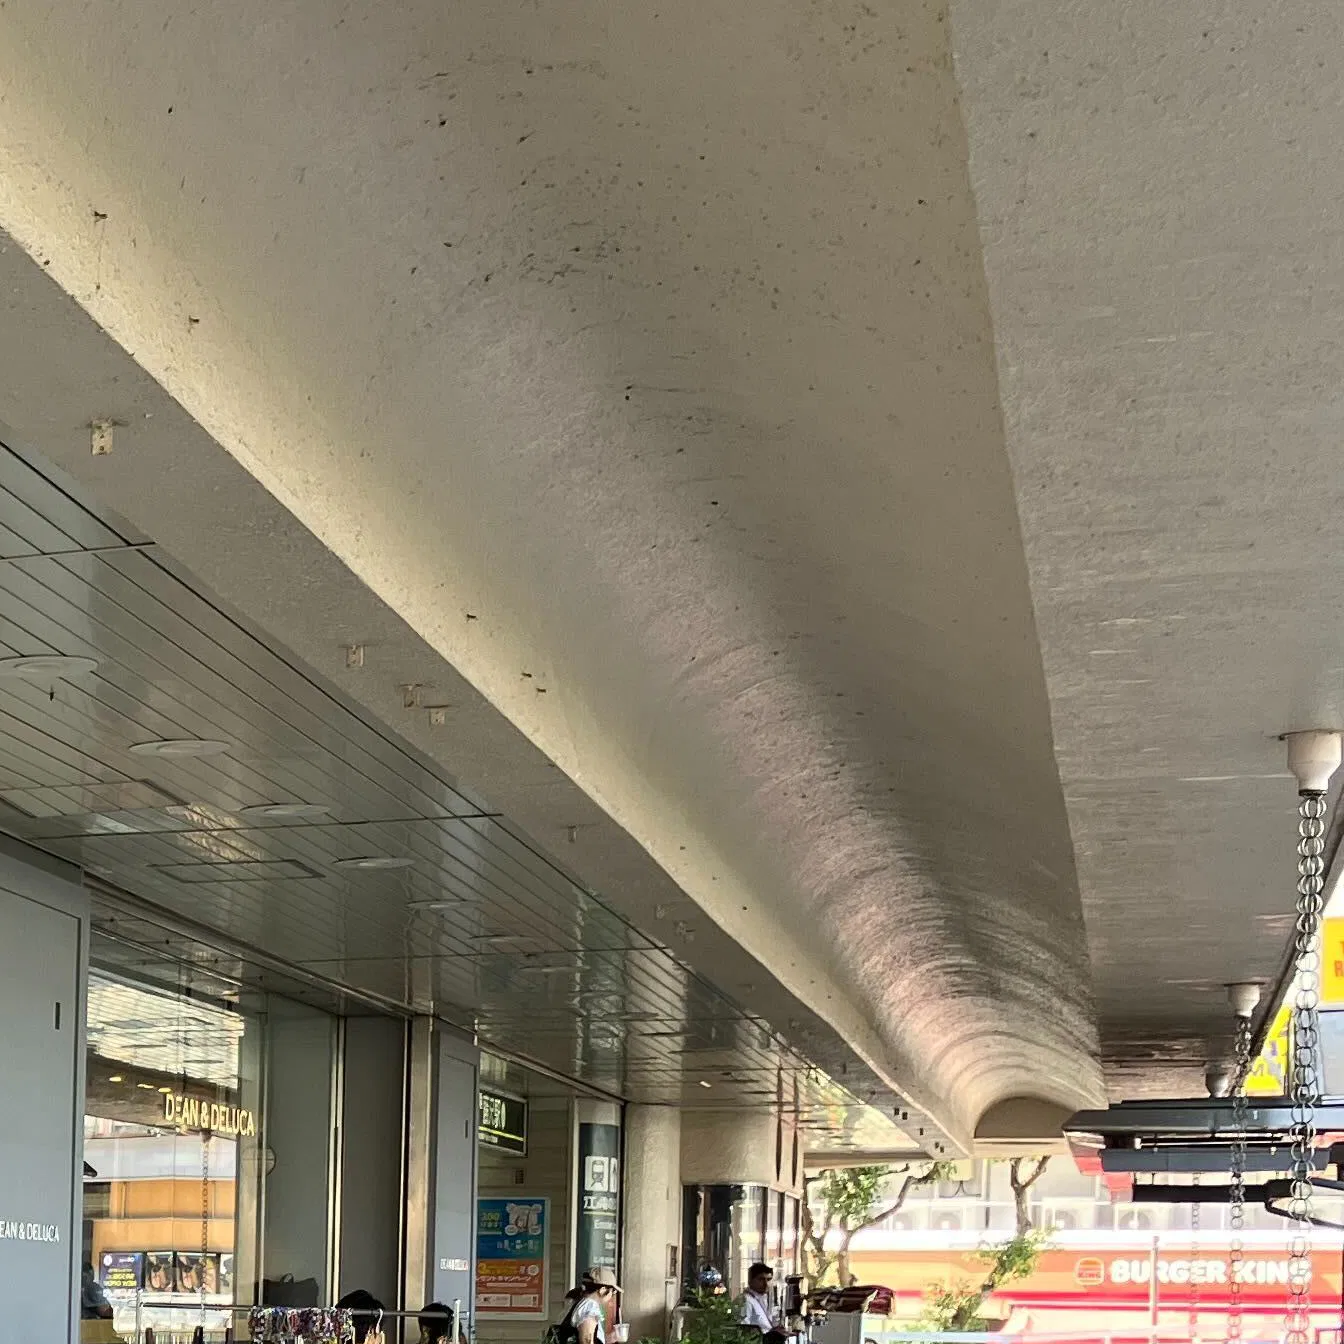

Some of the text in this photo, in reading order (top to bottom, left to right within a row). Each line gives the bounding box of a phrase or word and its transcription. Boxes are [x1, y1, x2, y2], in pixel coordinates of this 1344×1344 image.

[165, 1093, 255, 1136] DEAN & DELUCA
[19, 1222, 25, 1240] &
[27, 1223, 60, 1242] DELUCA
[1111, 1259, 1312, 1285] BURGER KING
